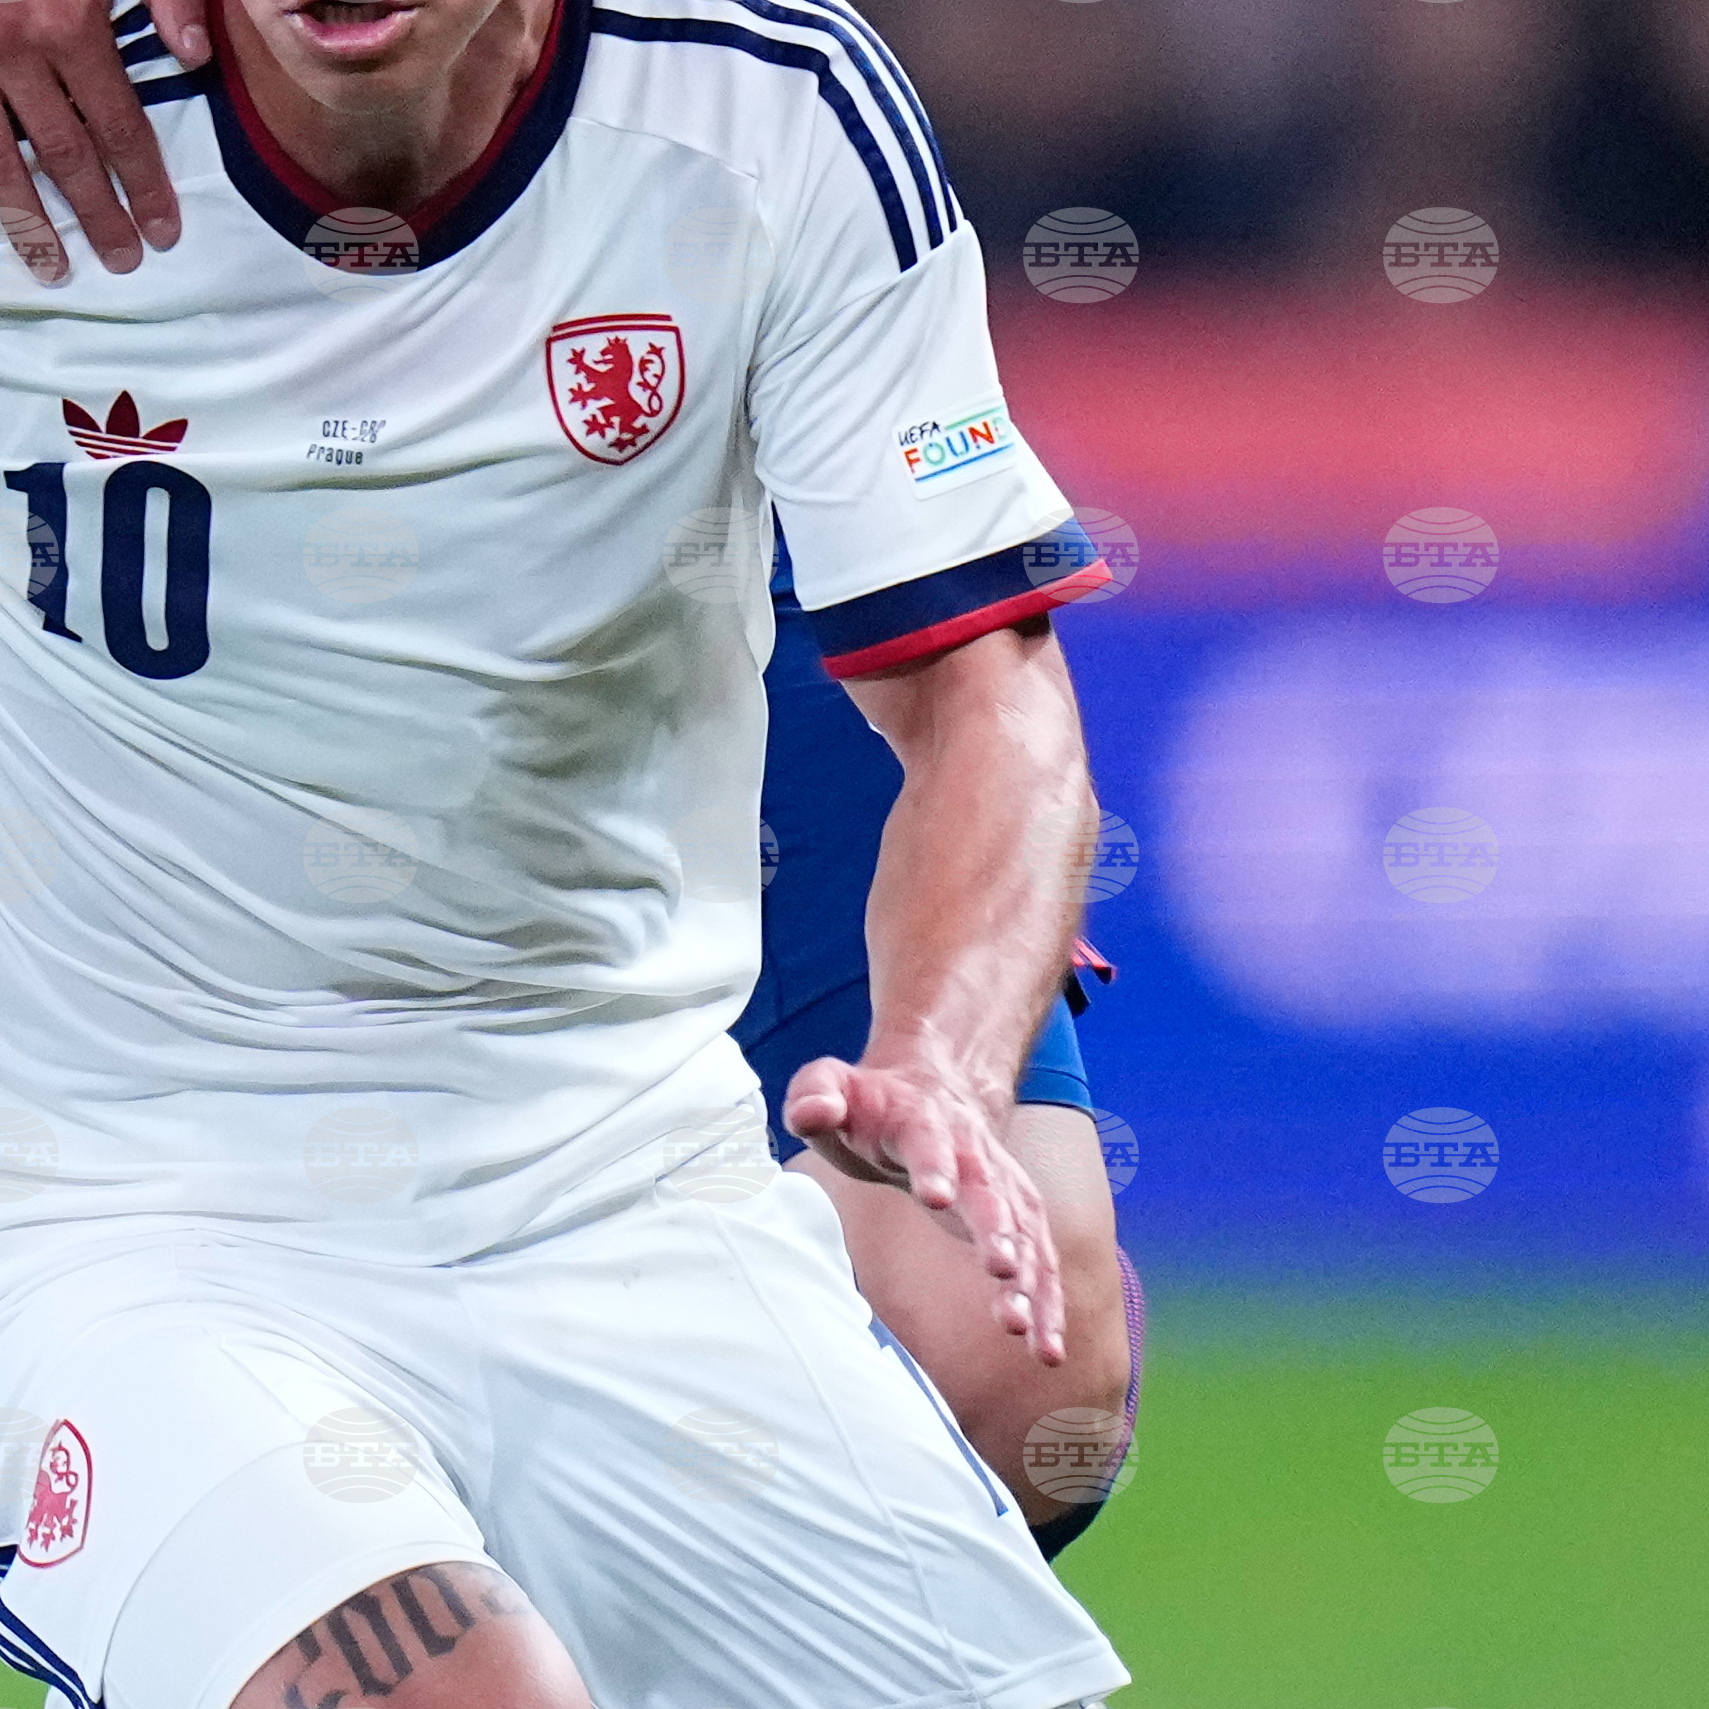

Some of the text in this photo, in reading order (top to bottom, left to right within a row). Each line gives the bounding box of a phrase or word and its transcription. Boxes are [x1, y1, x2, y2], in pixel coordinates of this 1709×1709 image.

[898, 421, 941, 446] UEFA
[307, 443, 363, 466] Prague
[3, 460, 212, 680] 10
